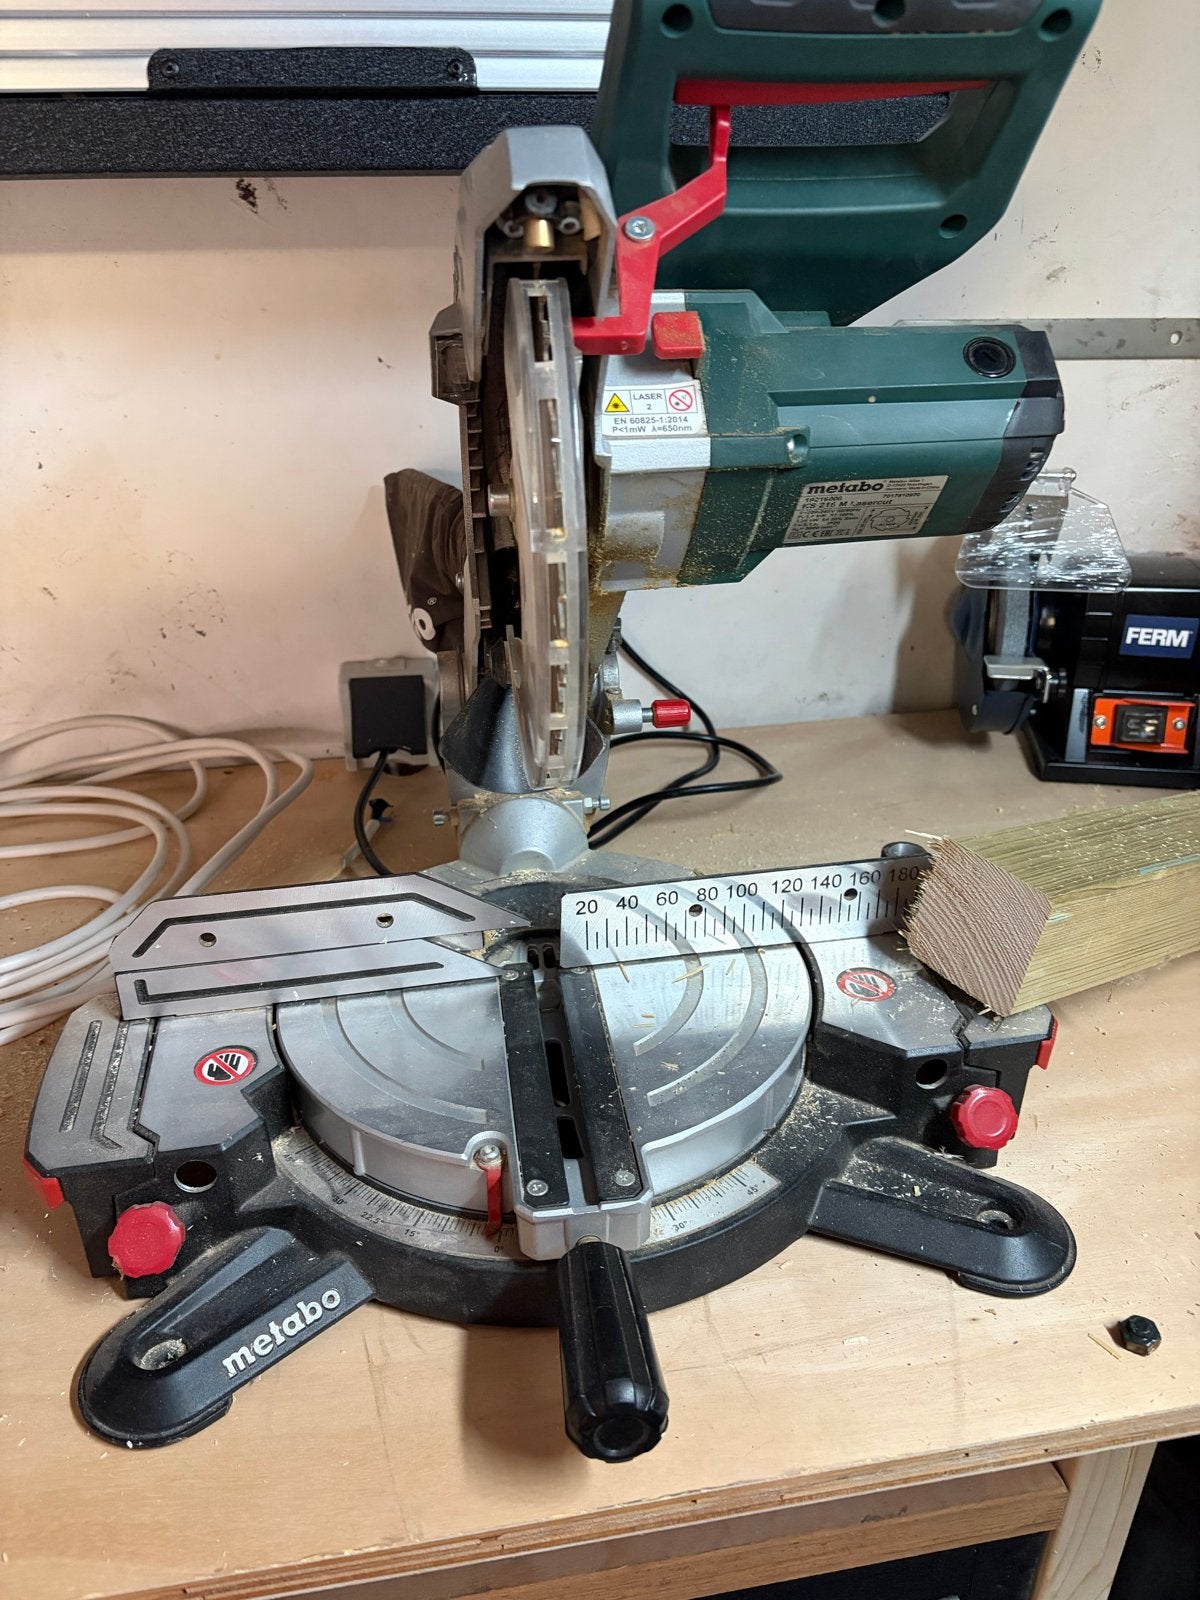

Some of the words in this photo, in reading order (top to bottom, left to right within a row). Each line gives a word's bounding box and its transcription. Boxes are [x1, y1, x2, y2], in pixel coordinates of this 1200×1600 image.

[614, 417, 627, 425] EN
[629, 416, 688, 424] 60825-1:2014
[807, 481, 884, 494] metabo
[1125, 627, 1189, 648] FERM
[575, 899, 599, 915] 20
[616, 895, 639, 910] 40
[656, 891, 679, 906] 60
[696, 886, 719, 902] 80
[727, 882, 759, 899] 100
[771, 878, 804, 895] 120
[811, 873, 843, 890] 140
[849, 869, 882, 886] 160
[889, 865, 920, 882] 180
[747, 1184, 759, 1196] 45°
[672, 1220, 688, 1232] 30°
[222, 1289, 341, 1378] metabo
